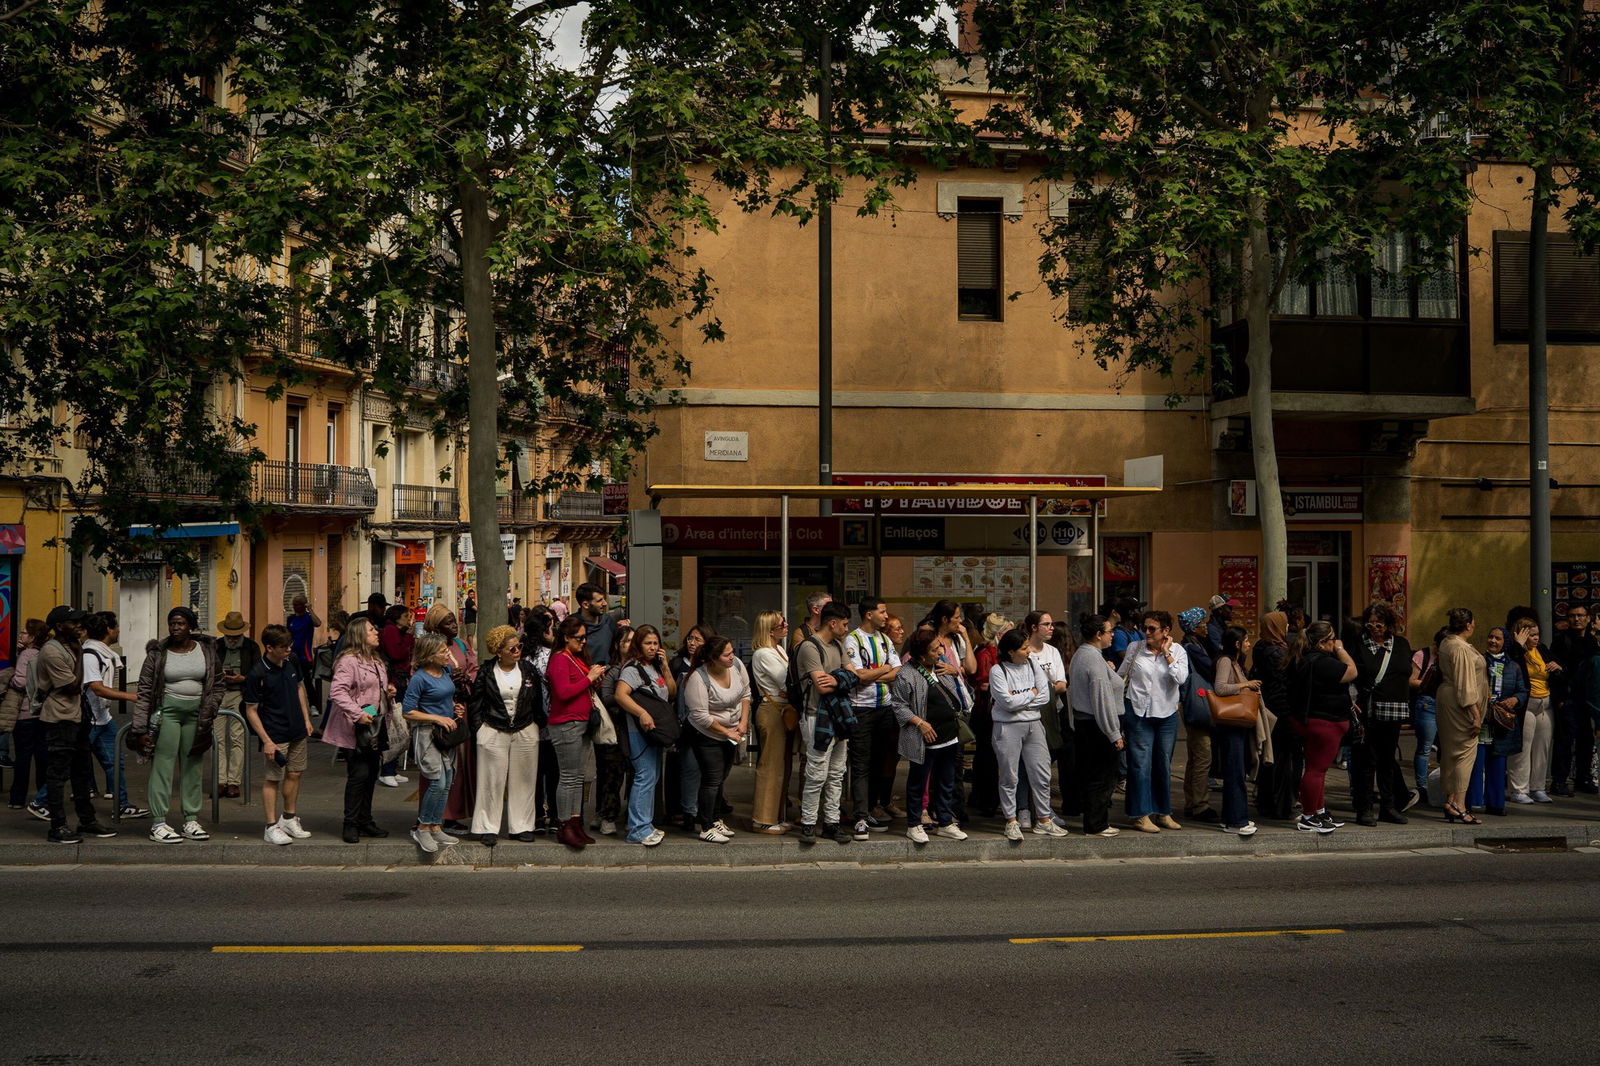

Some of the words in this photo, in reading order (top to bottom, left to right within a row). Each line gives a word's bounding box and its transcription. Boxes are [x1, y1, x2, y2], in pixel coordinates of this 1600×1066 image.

[1295, 495, 1343, 510] ISTAMBUL
[684, 524, 716, 540] Àrea
[720, 527, 793, 540] d'intercani
[796, 527, 824, 540] Clot
[884, 526, 939, 541] Enllaços
[1024, 527, 1047, 538] H0
[1053, 527, 1075, 538] H10
